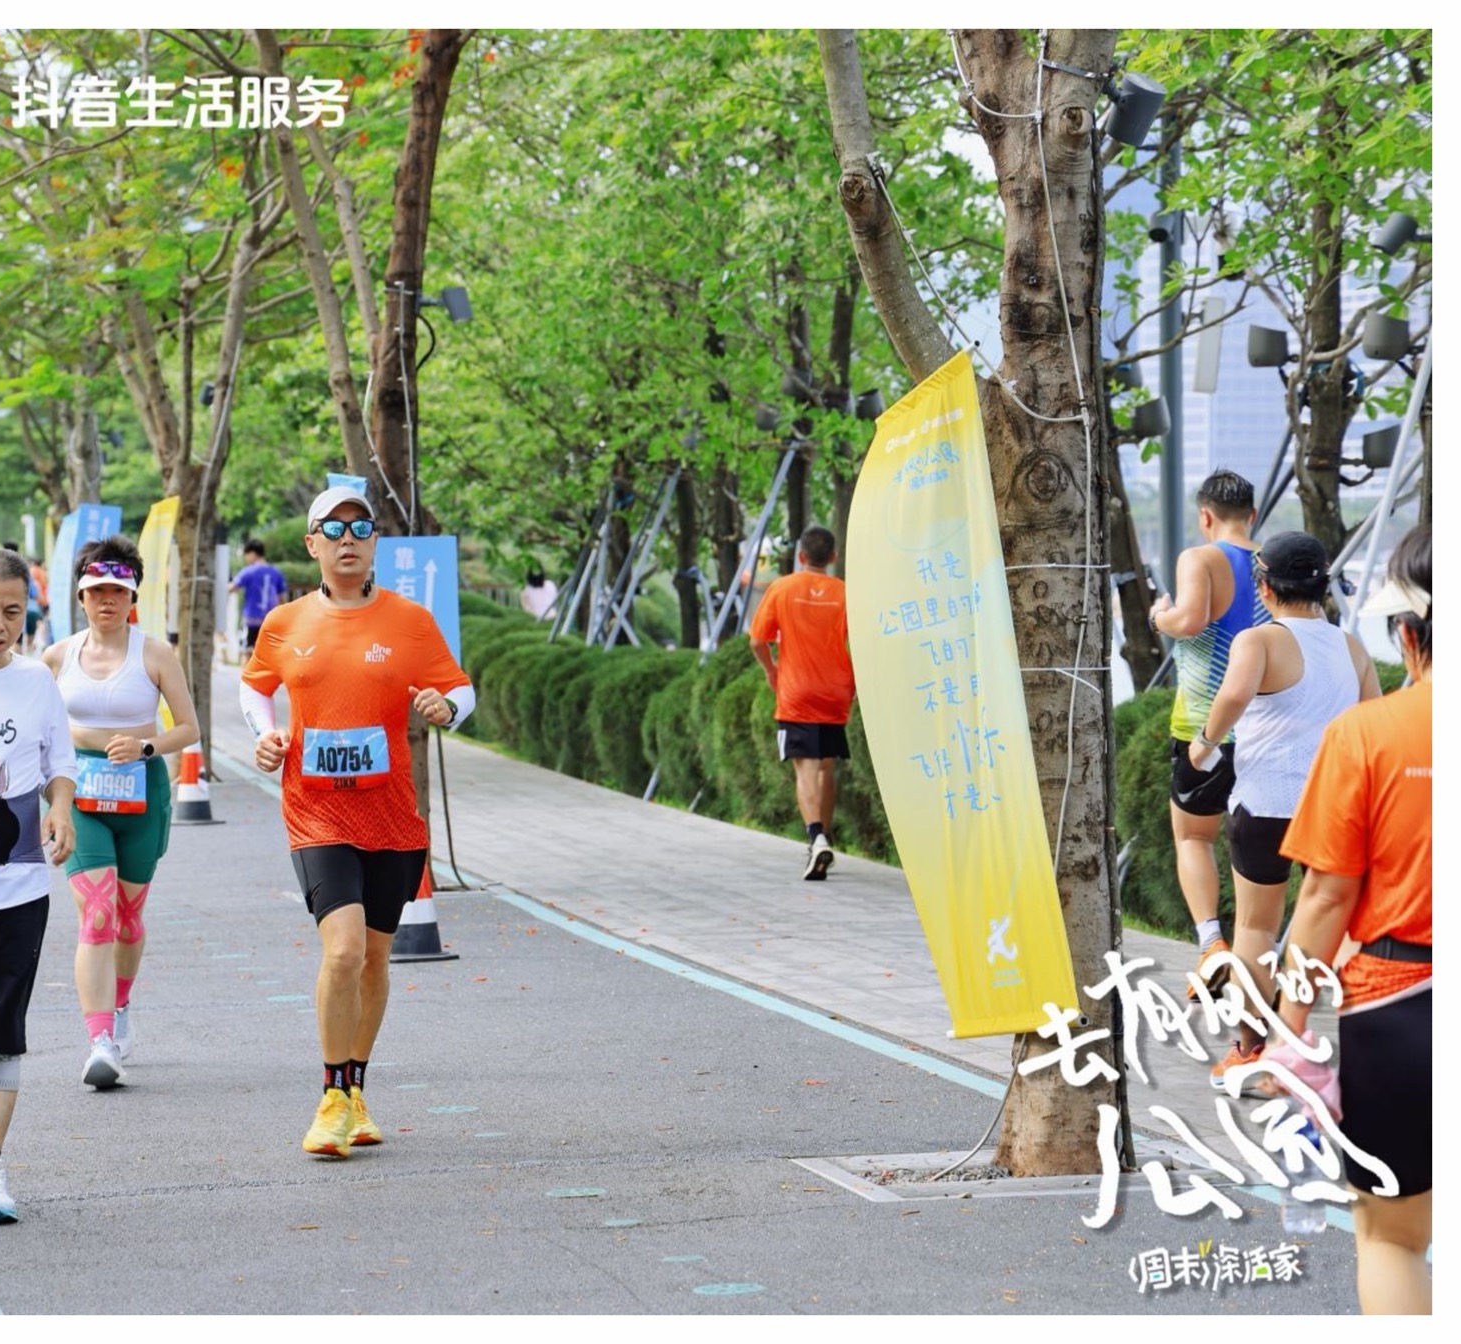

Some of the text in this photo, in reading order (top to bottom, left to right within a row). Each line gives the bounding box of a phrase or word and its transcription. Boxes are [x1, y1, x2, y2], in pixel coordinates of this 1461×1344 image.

[316, 745, 373, 773] A0754
[333, 777, 357, 790] 21KM
[97, 800, 118, 812] 21KM
